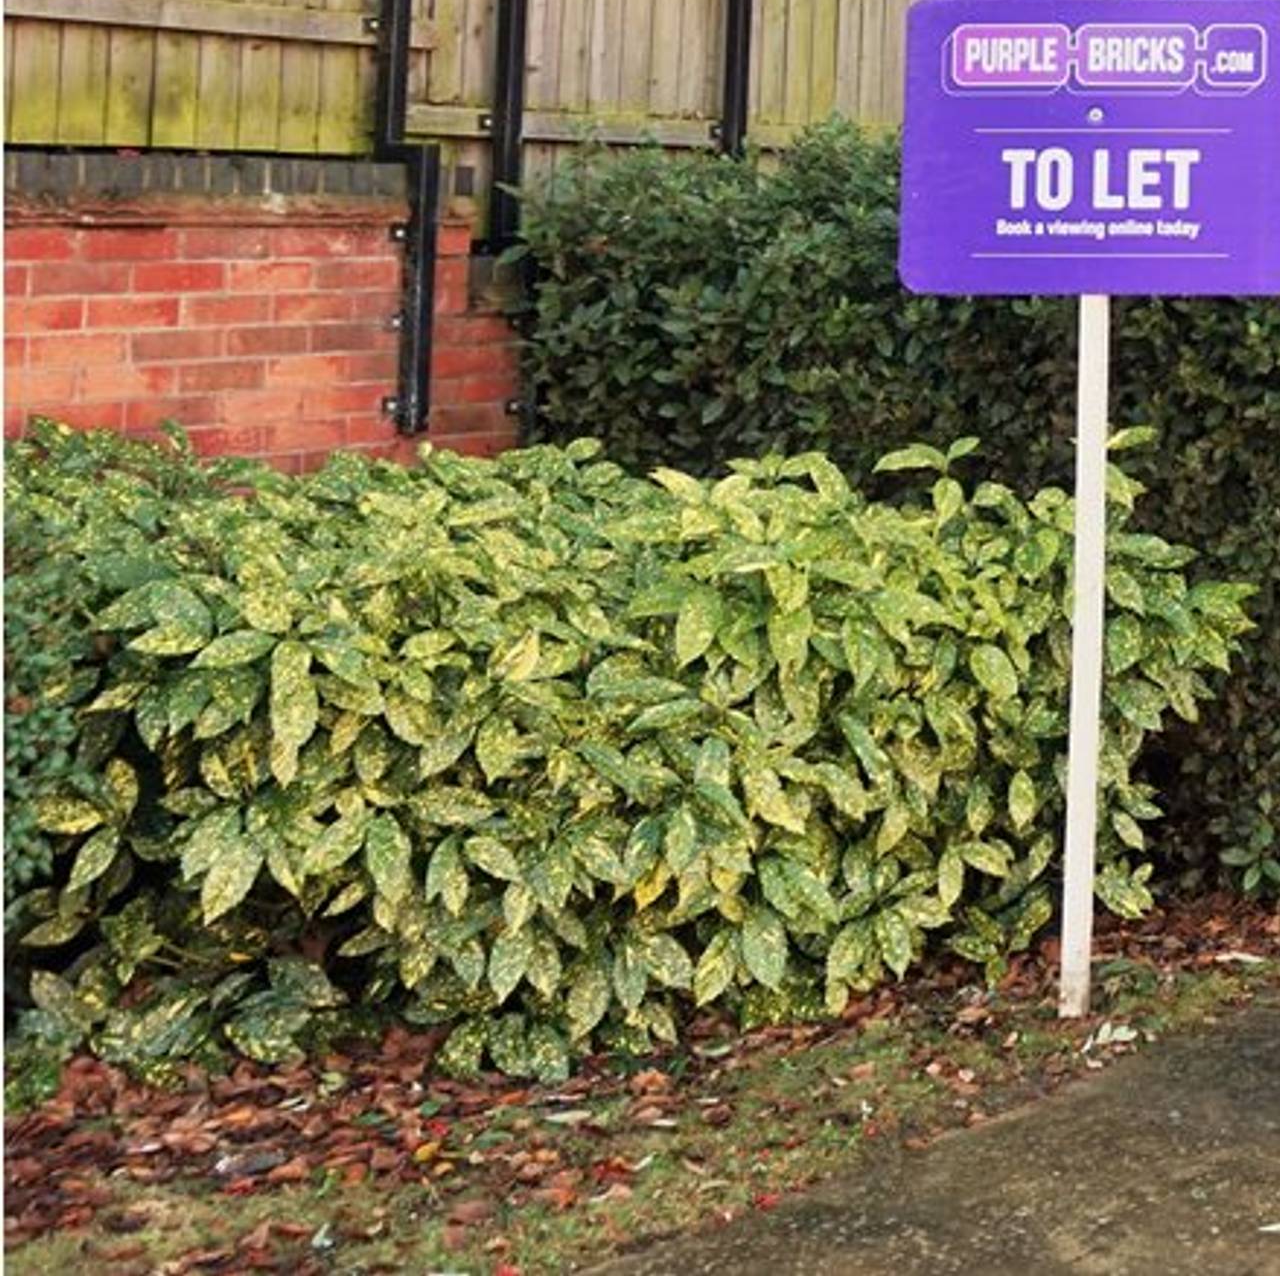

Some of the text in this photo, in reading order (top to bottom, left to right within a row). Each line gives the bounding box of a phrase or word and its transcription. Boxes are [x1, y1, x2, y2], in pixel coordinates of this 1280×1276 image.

[965, 37, 1254, 74] PURPLE BRICKS .COM
[1002, 148, 1199, 211] TO LET
[996, 219, 1200, 240] Book a viewing online today
